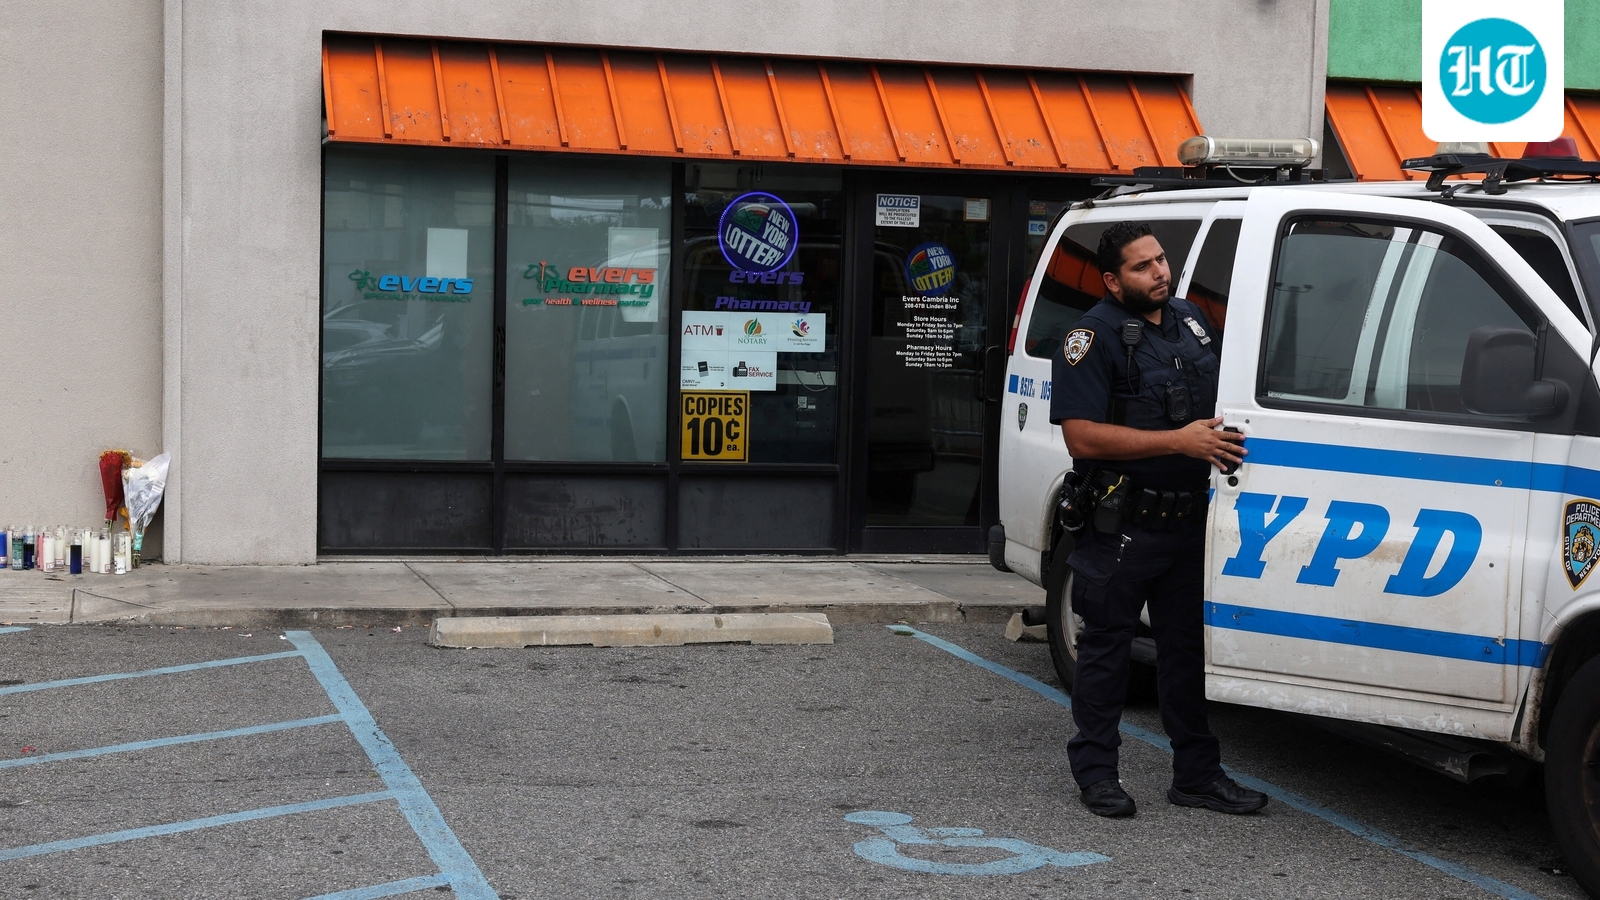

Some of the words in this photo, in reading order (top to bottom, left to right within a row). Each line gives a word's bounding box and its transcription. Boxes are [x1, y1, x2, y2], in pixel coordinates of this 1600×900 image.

[879, 197, 918, 207] NOTICE
[768, 209, 790, 233] NEW
[762, 222, 789, 250] YORK
[725, 223, 784, 267] LOTTERY
[926, 246, 945, 257] NEW
[929, 254, 952, 270] YORK
[568, 266, 656, 284] evers
[729, 270, 805, 285] evers
[911, 265, 955, 291] LOTTERY
[378, 274, 474, 294] evers
[545, 279, 655, 298] Pharmacy
[364, 292, 417, 301] SPECIALITY
[420, 294, 473, 303] PHARMACY
[545, 297, 572, 306] health
[581, 297, 617, 306] wellness
[617, 299, 650, 308] partner
[714, 296, 812, 314] Pharmacy
[902, 295, 921, 303] Evers
[922, 295, 949, 303] Cambria
[683, 325, 713, 336] ATM
[737, 337, 768, 345] NOTARY
[906, 344, 934, 352] Pharmacy
[1040, 380, 1052, 401] 105
[685, 396, 743, 416] COPIES
[687, 417, 741, 456] 10¢
[1575, 503, 1600, 517] POLICE
[1566, 513, 1600, 529] DEPARTME
[1209, 489, 1482, 598] YPD
[1565, 560, 1571, 571] OF
[1579, 562, 1592, 580] NEW
